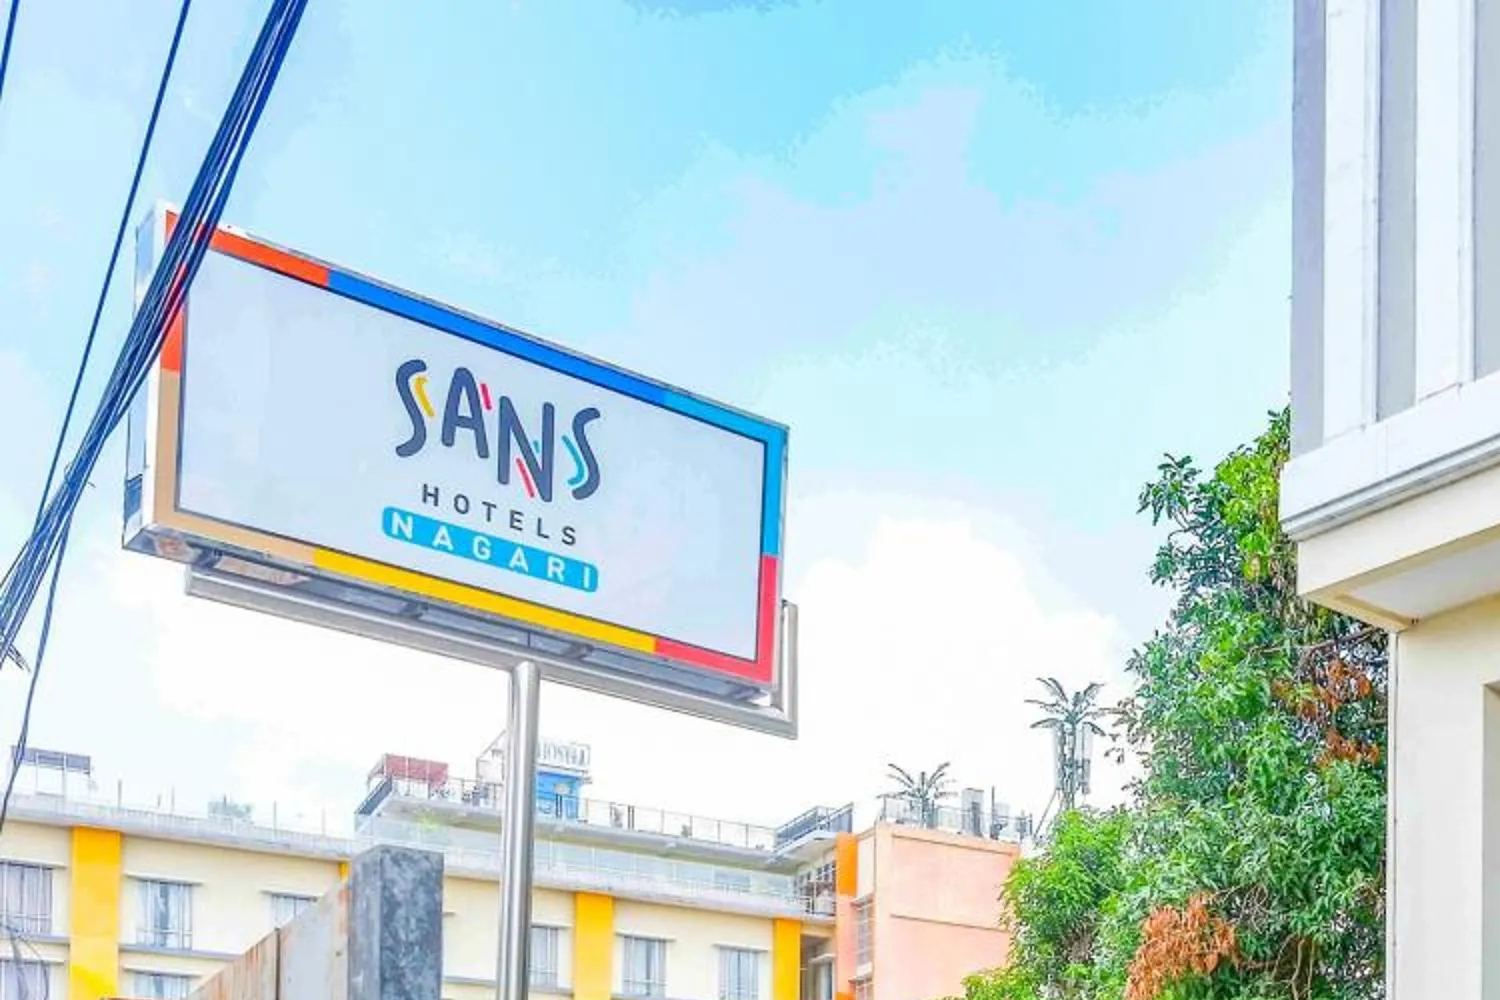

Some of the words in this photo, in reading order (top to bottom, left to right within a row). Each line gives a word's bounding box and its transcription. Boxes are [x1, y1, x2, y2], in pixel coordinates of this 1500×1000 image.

[395, 359, 601, 502] SANS
[391, 511, 591, 589] NAGARI
[421, 483, 577, 545] HOTELS
